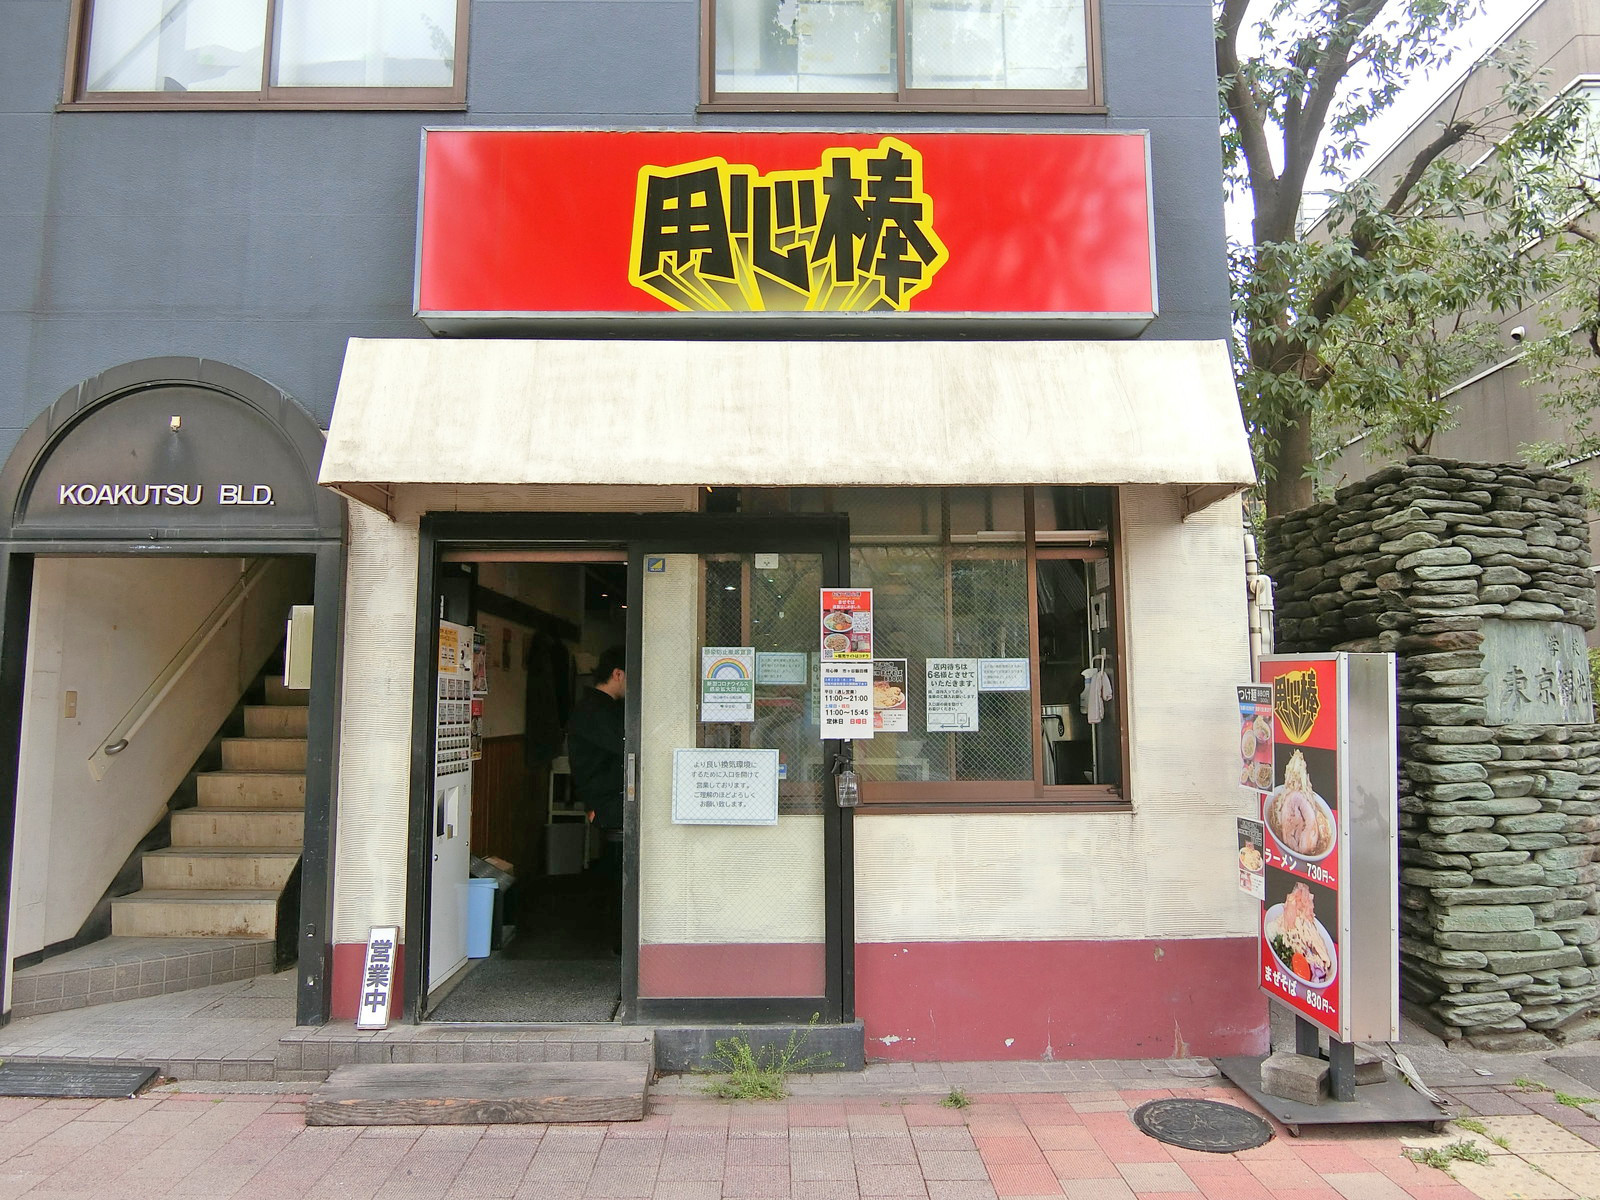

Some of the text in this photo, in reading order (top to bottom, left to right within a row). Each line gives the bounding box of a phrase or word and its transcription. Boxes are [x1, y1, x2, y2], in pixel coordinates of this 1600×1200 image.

[638, 146, 940, 306] 用心棒
[59, 483, 276, 506] KOAKUTSU BLD.
[927, 671, 974, 679] 6名様とさせて
[930, 680, 976, 688] いただきます。
[1273, 668, 1320, 728] 用心棒
[693, 760, 758, 769] より良い換気環境に
[693, 791, 757, 799] ご理解のほどよろしく
[699, 800, 748, 808] お願い致します。
[1265, 847, 1298, 872] ラーメン
[364, 939, 393, 1013] 営業中
[1264, 966, 1298, 998] まぜそば
